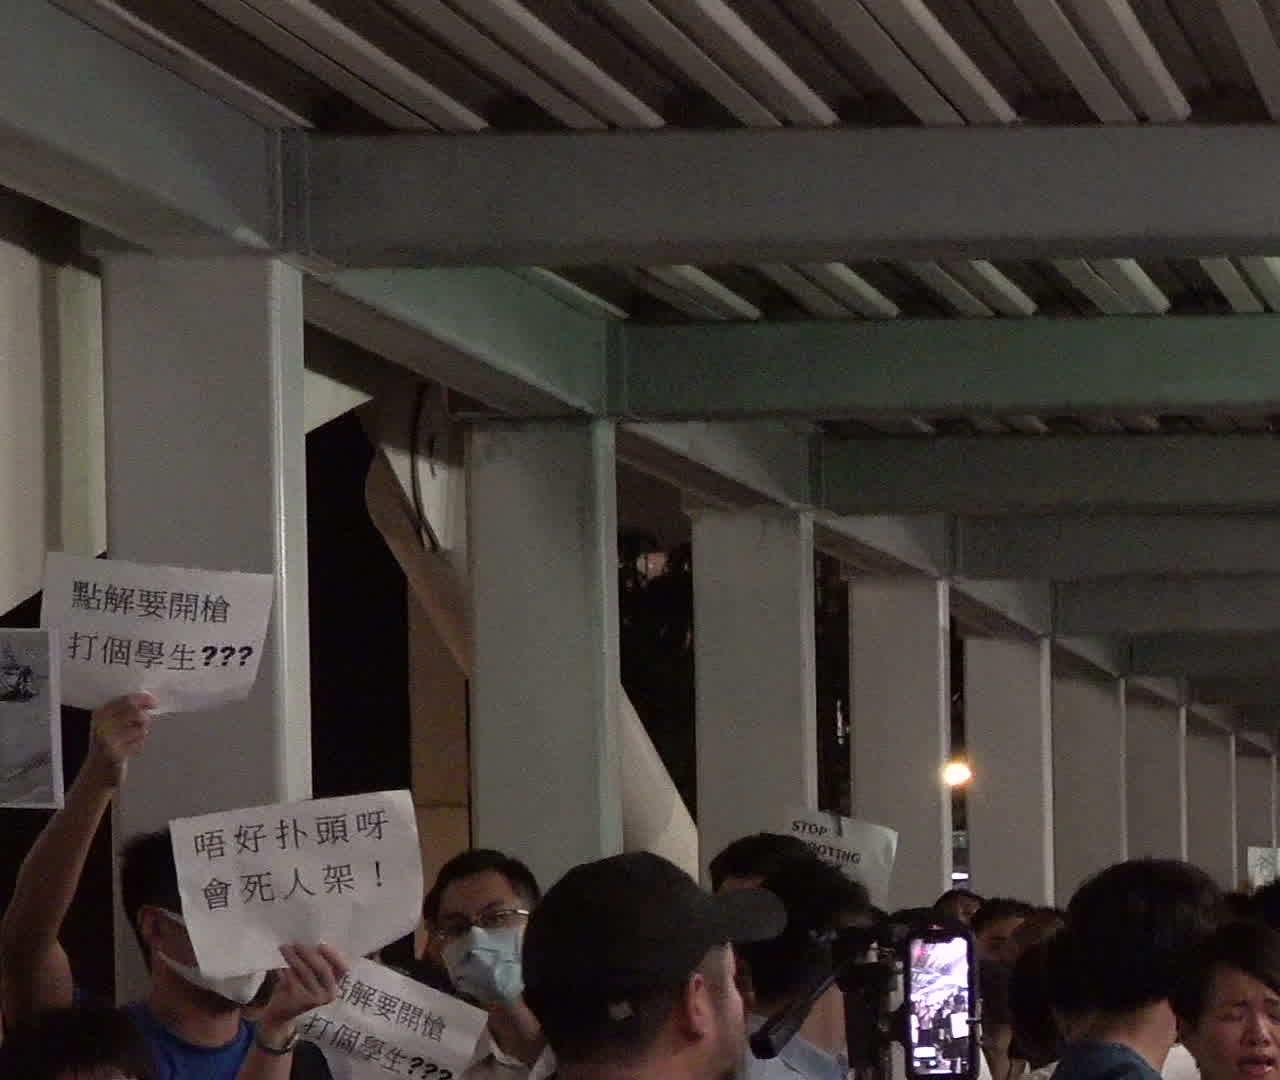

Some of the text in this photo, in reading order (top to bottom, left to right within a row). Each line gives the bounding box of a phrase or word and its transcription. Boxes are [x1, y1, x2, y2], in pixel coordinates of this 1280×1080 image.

[72, 580, 231, 624] 點解要開槍
[67, 631, 253, 672] 打個學生???
[193, 808, 389, 861] 唔好扑頭呀
[791, 819, 828, 836] STOP
